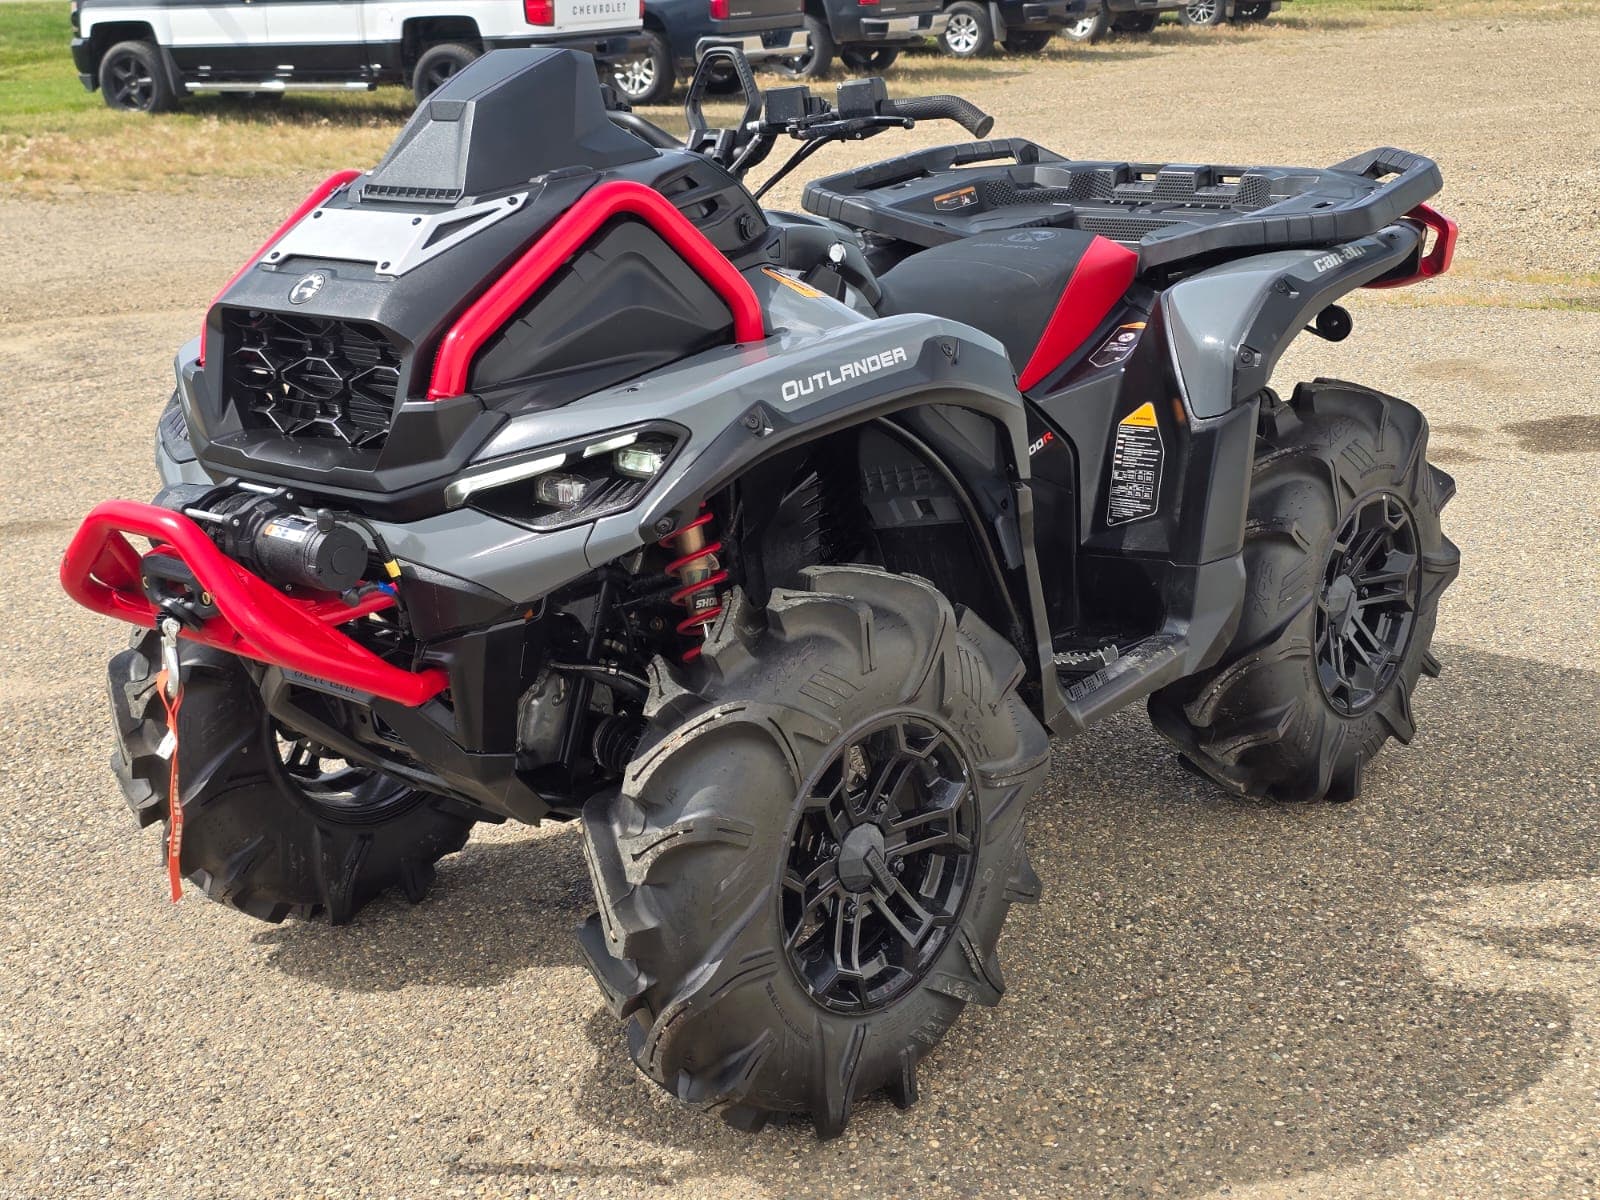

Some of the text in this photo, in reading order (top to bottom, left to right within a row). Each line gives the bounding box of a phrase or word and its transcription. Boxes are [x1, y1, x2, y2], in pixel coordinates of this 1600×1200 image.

[572, 3, 626, 16] CHEVROLET
[1313, 245, 1367, 273] can-am
[781, 346, 908, 402] OUTLANDER
